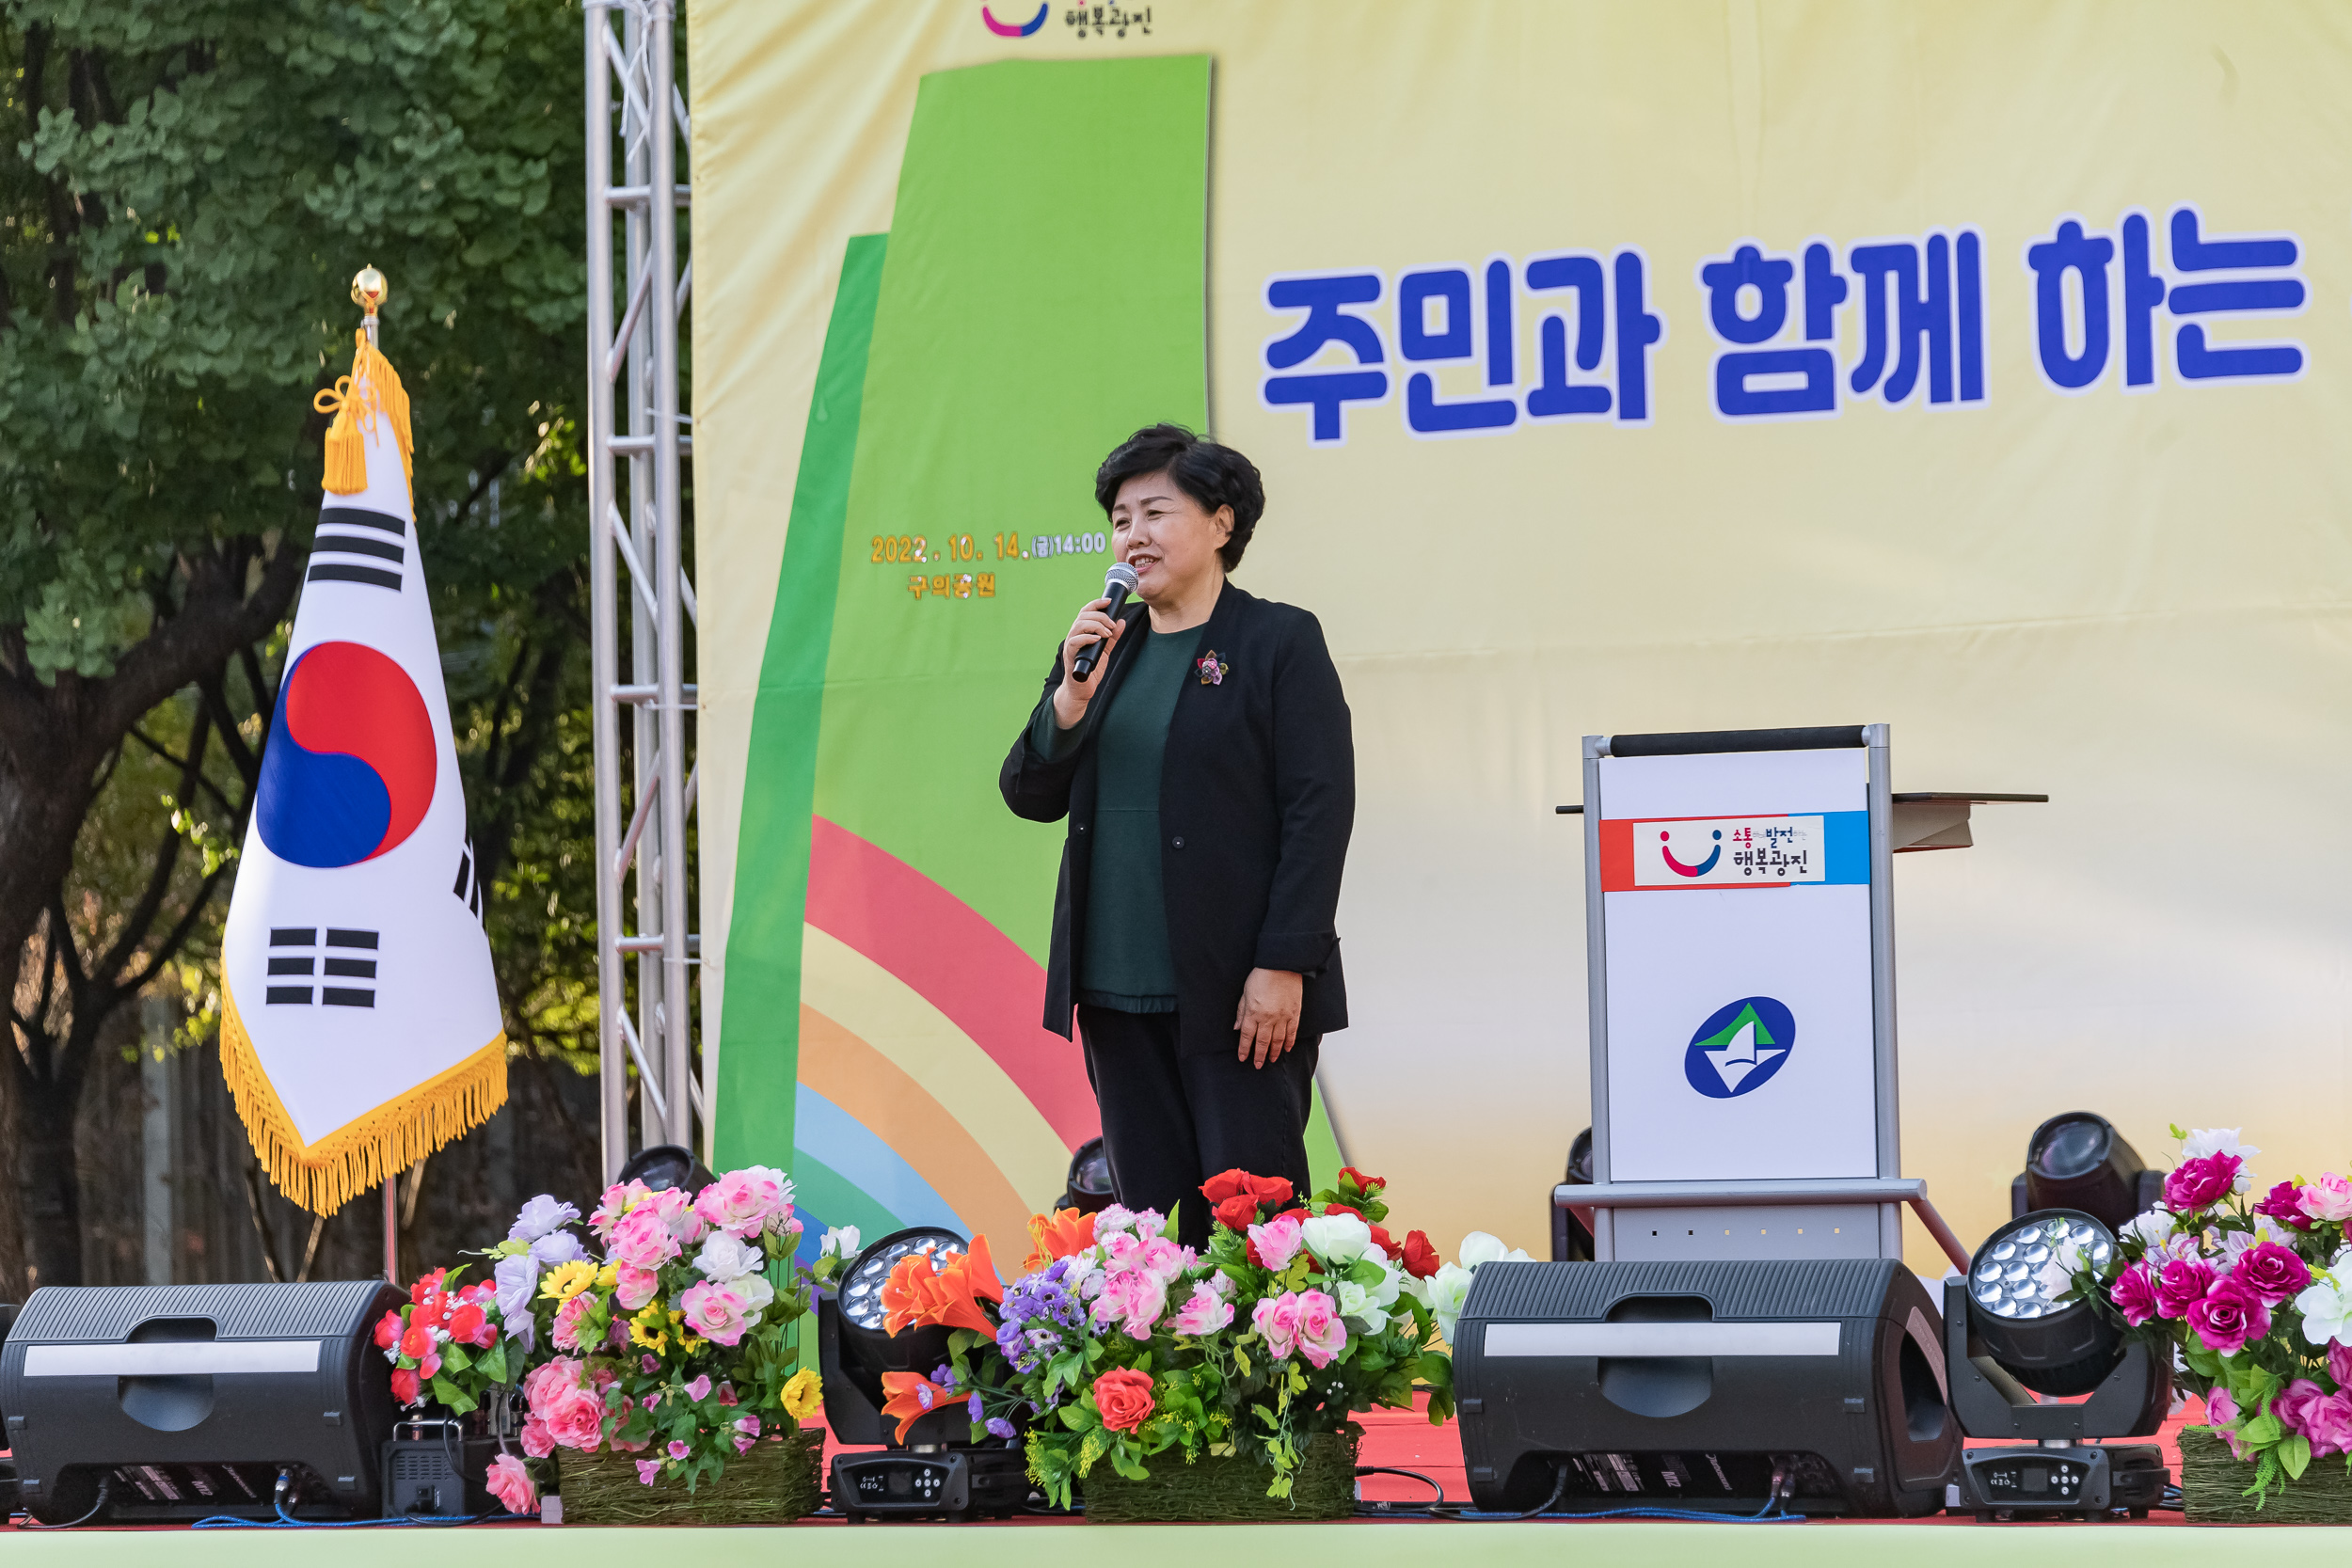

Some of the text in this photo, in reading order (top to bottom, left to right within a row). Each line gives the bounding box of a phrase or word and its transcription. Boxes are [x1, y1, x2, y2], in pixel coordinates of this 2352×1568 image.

[1264, 209, 2306, 441] 주민과 함께 하는
[948, 533, 983, 562] 10.
[908, 573, 995, 600] 구의공원
[1733, 847, 1807, 877] 행복광진
